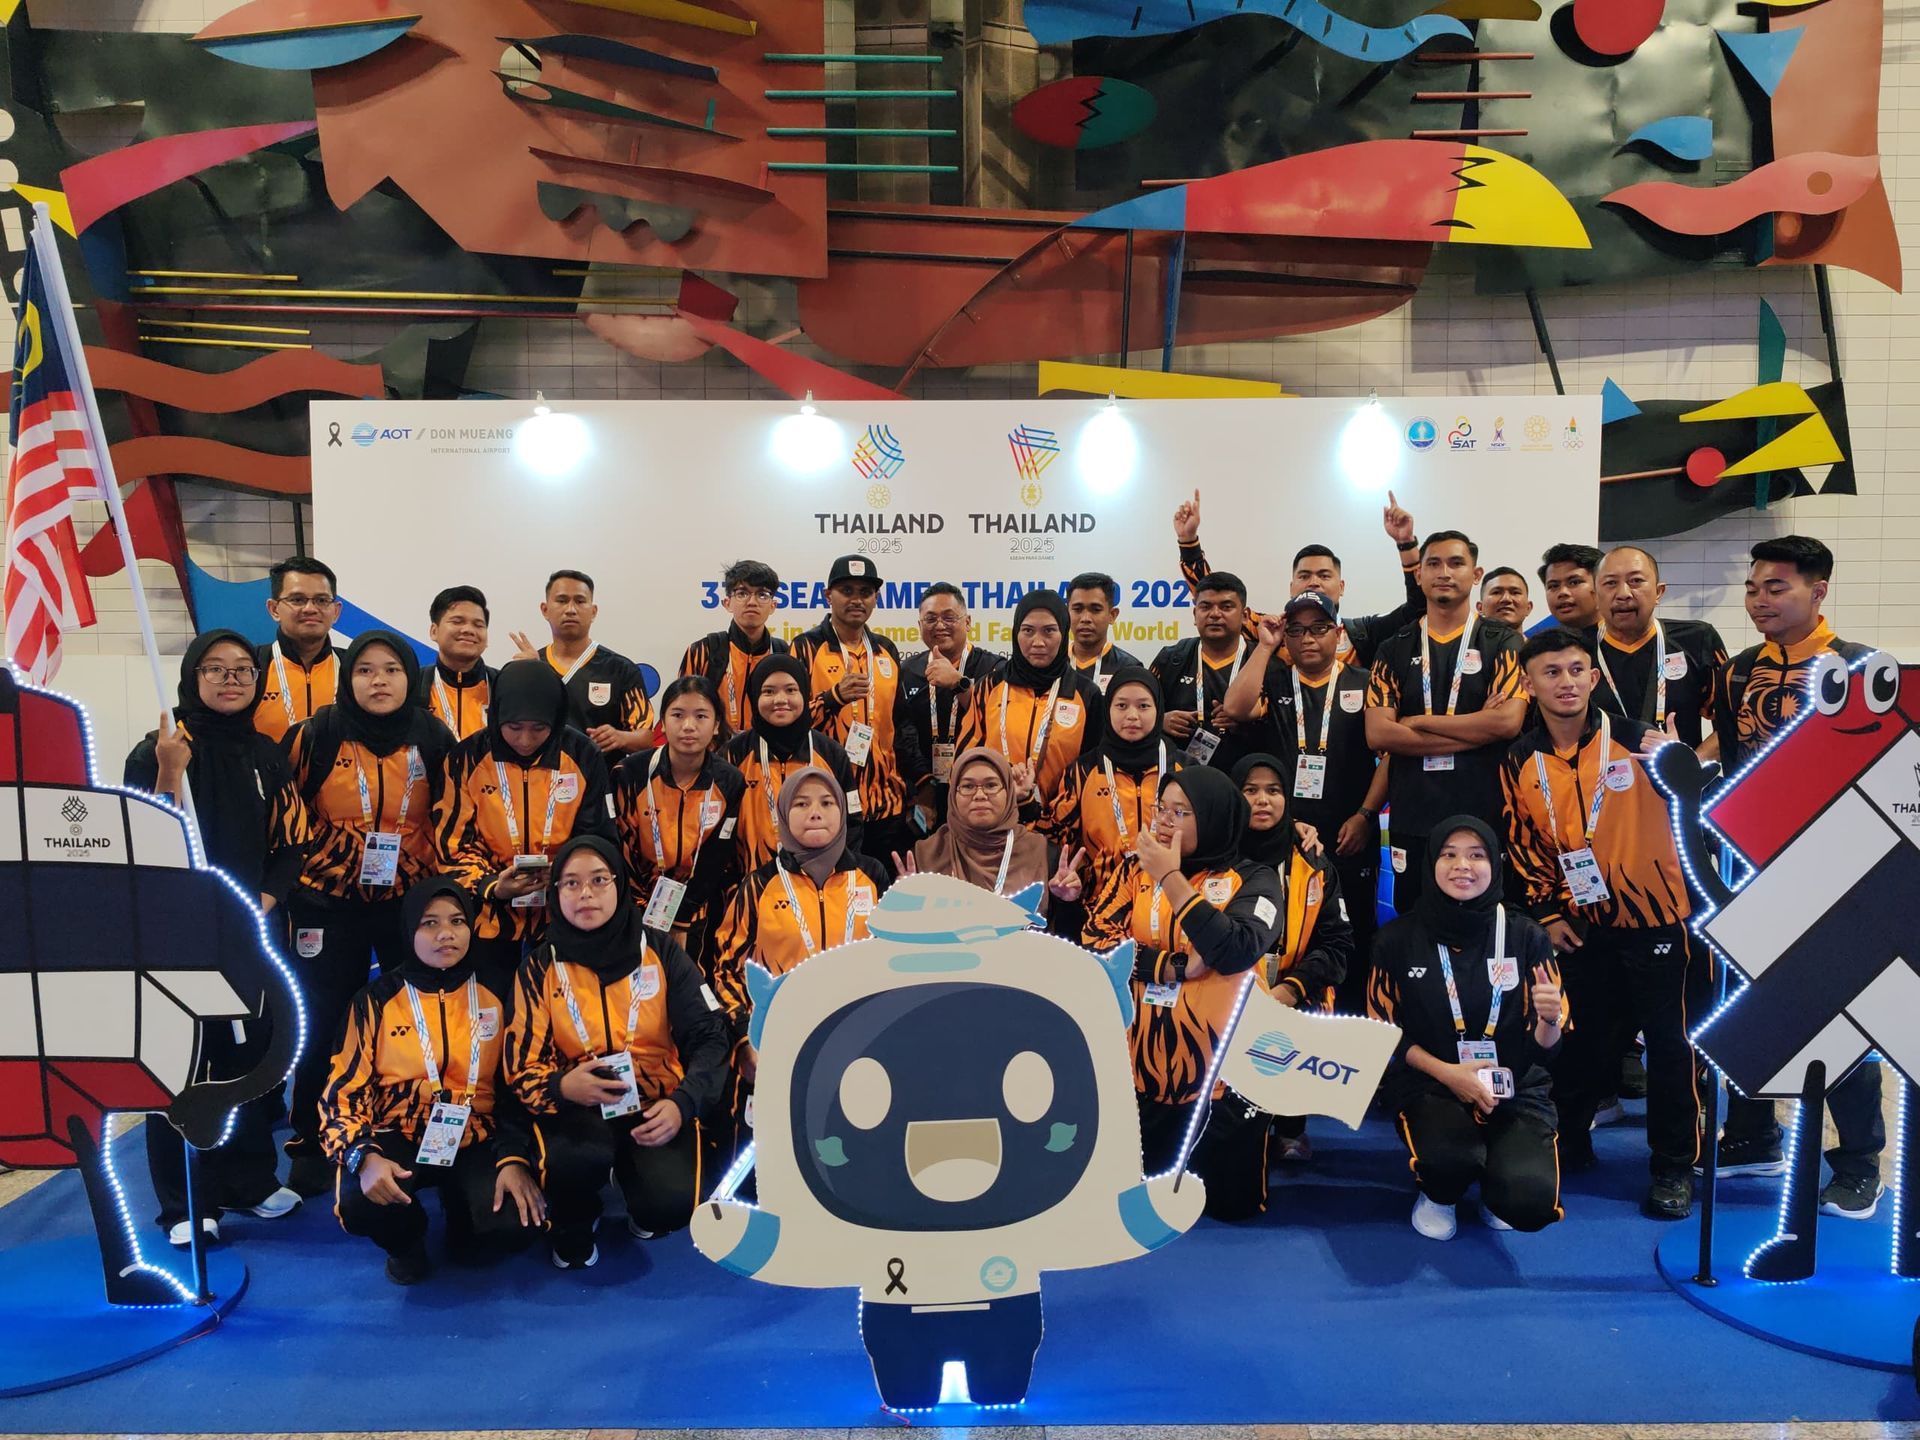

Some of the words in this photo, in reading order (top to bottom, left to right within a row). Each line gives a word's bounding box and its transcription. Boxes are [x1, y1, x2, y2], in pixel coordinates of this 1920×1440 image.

[380, 428, 413, 440] AOT
[430, 428, 456, 440] DON
[460, 428, 514, 440] MUEANG
[814, 513, 945, 534] THAILAND
[968, 513, 1096, 534] THAILAND
[856, 537, 904, 554] 2025
[1009, 537, 1056, 554] 2025
[1131, 580, 1198, 608] 202
[1111, 620, 1179, 641] World
[43, 837, 111, 848] THAILAND
[1296, 1055, 1360, 1085] AOT
